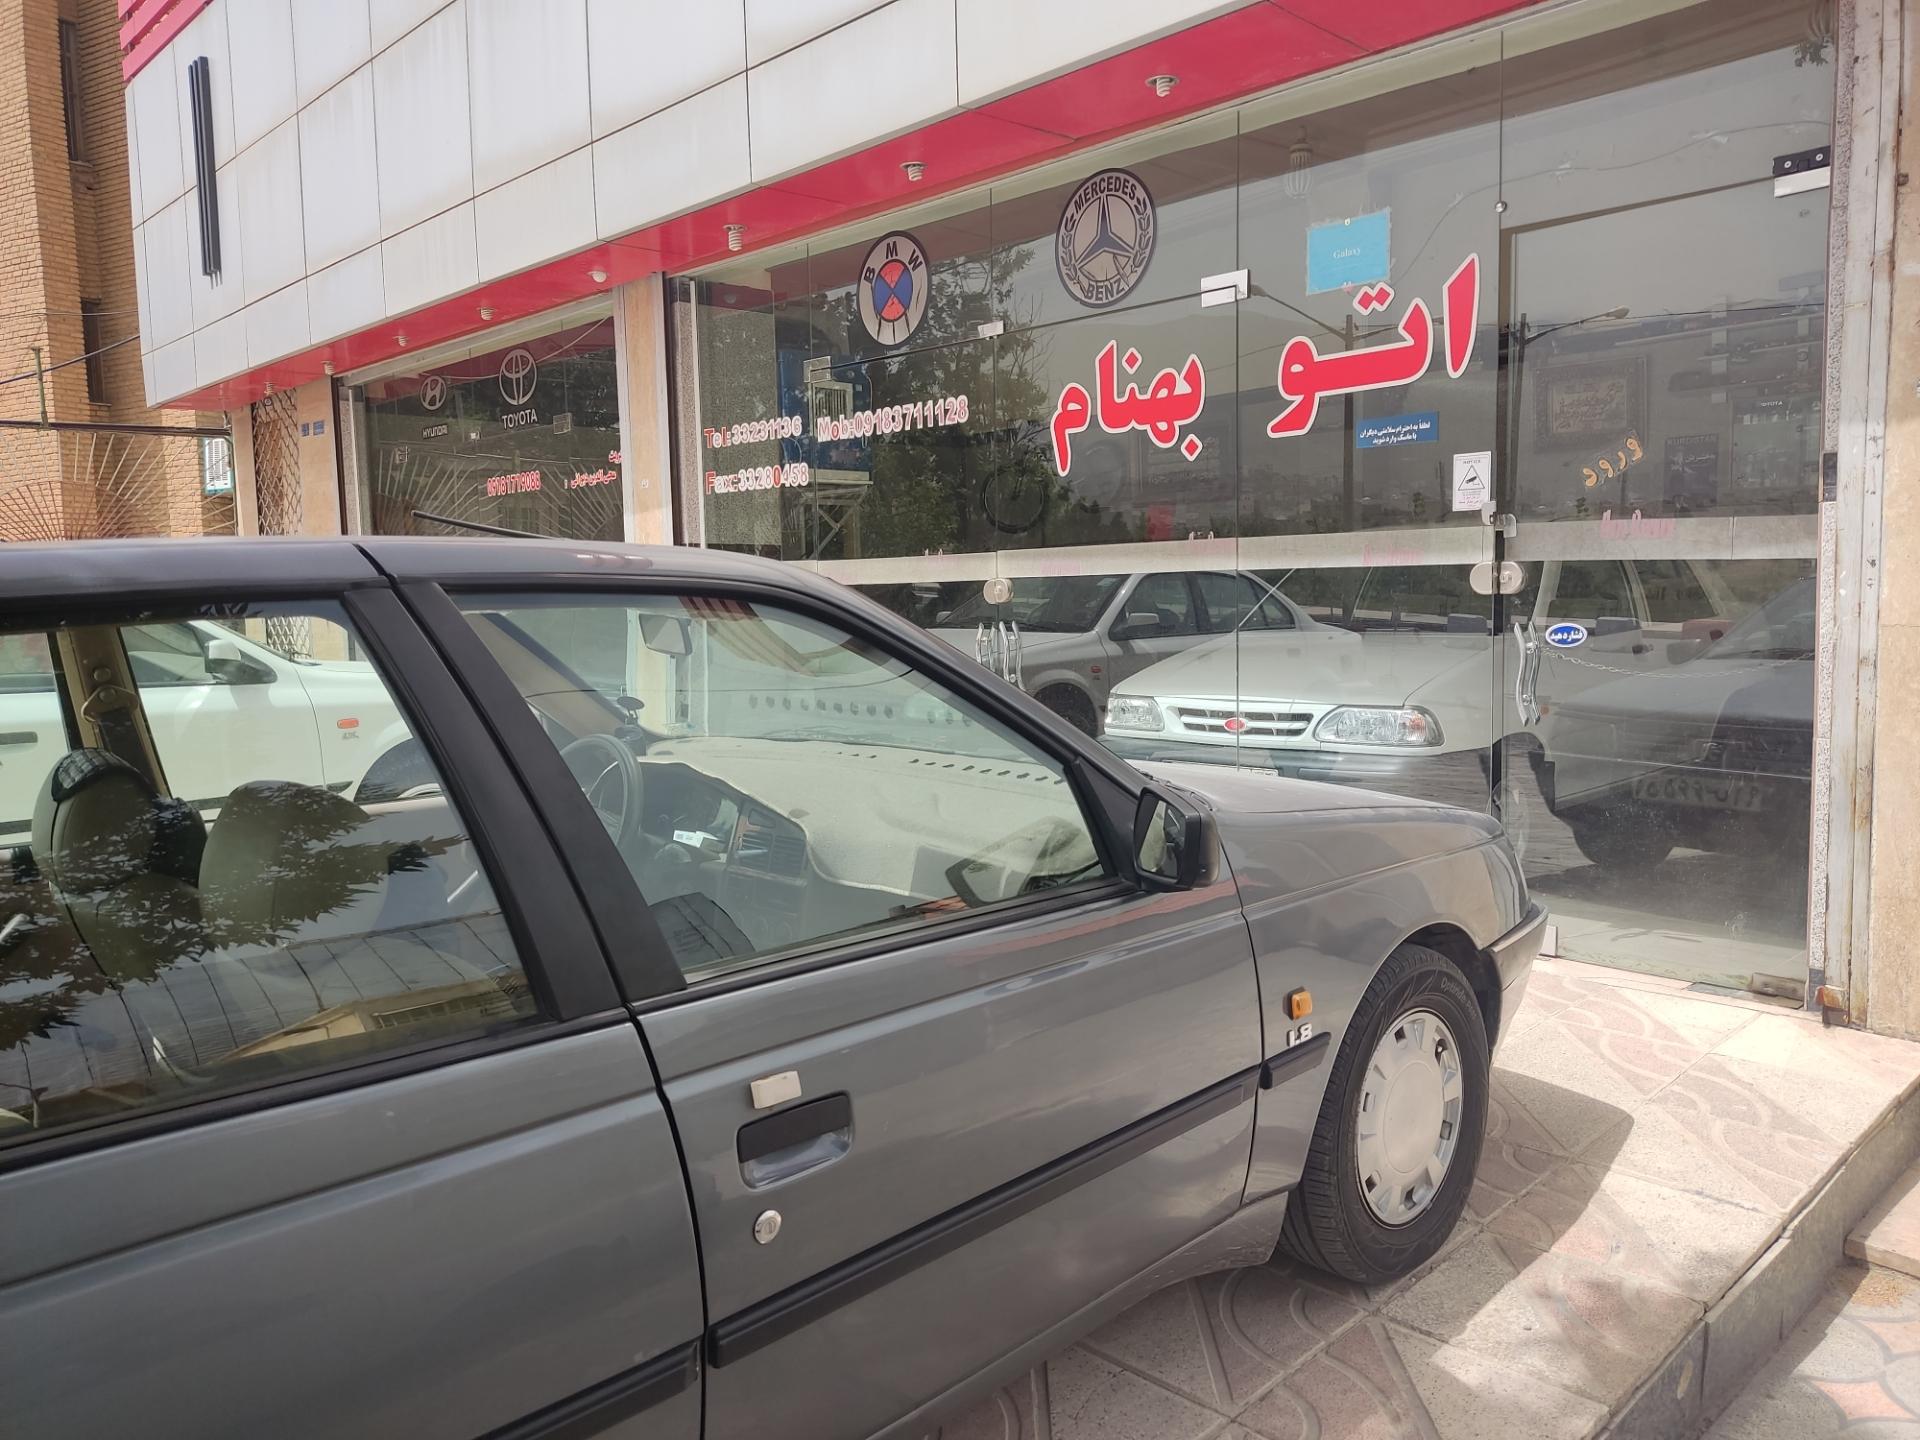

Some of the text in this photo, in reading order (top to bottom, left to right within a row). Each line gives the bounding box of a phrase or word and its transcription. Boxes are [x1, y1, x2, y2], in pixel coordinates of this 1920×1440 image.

[1074, 176, 1138, 214] MERCEDES
[863, 240, 923, 285] BMW
[1085, 277, 1126, 302] BENZ
[1050, 252, 1480, 477] اتو بهنام
[501, 408, 538, 430] TOYOTA
[816, 394, 969, 443] Mob:09183711128
[1582, 437, 1643, 488] ورود
